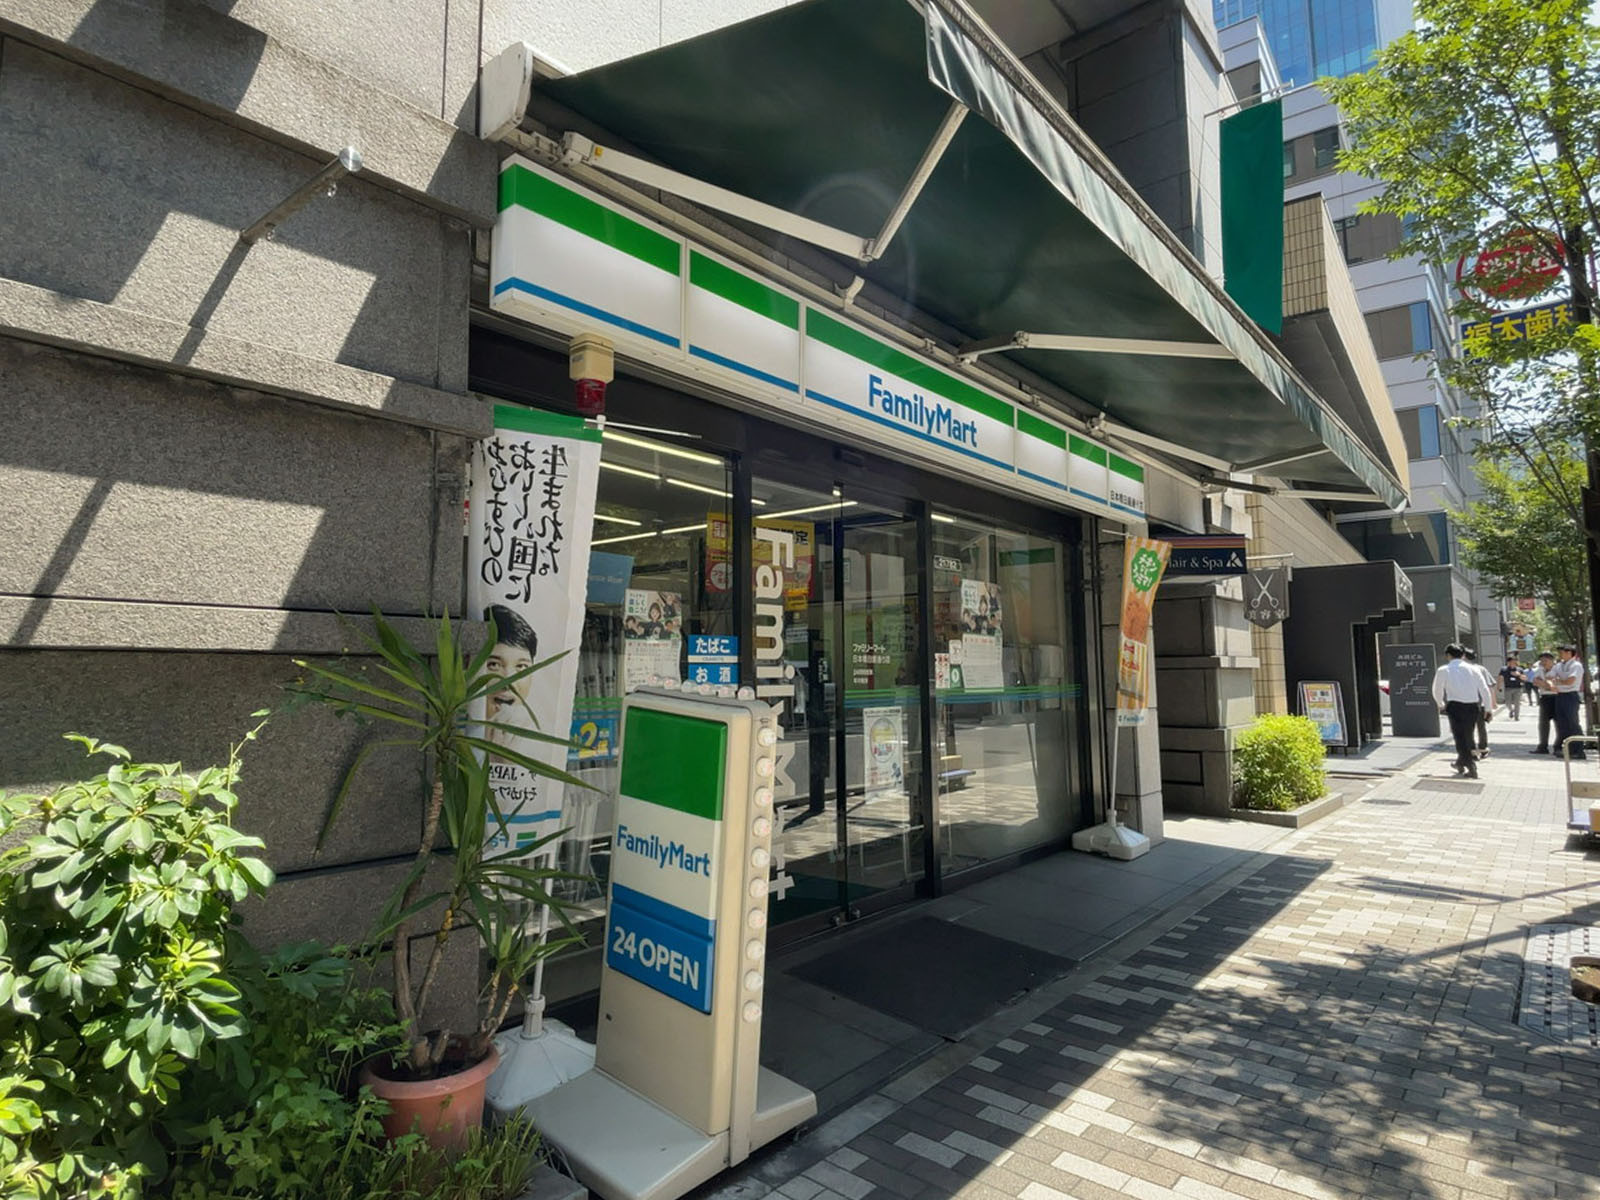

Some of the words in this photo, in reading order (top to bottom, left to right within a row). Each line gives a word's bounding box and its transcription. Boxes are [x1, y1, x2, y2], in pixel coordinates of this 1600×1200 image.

[868, 374, 978, 448] FamilyMart
[1203, 556, 1223, 571] Spa
[695, 637, 731, 654] たばこ
[616, 824, 711, 877] FamilyMart
